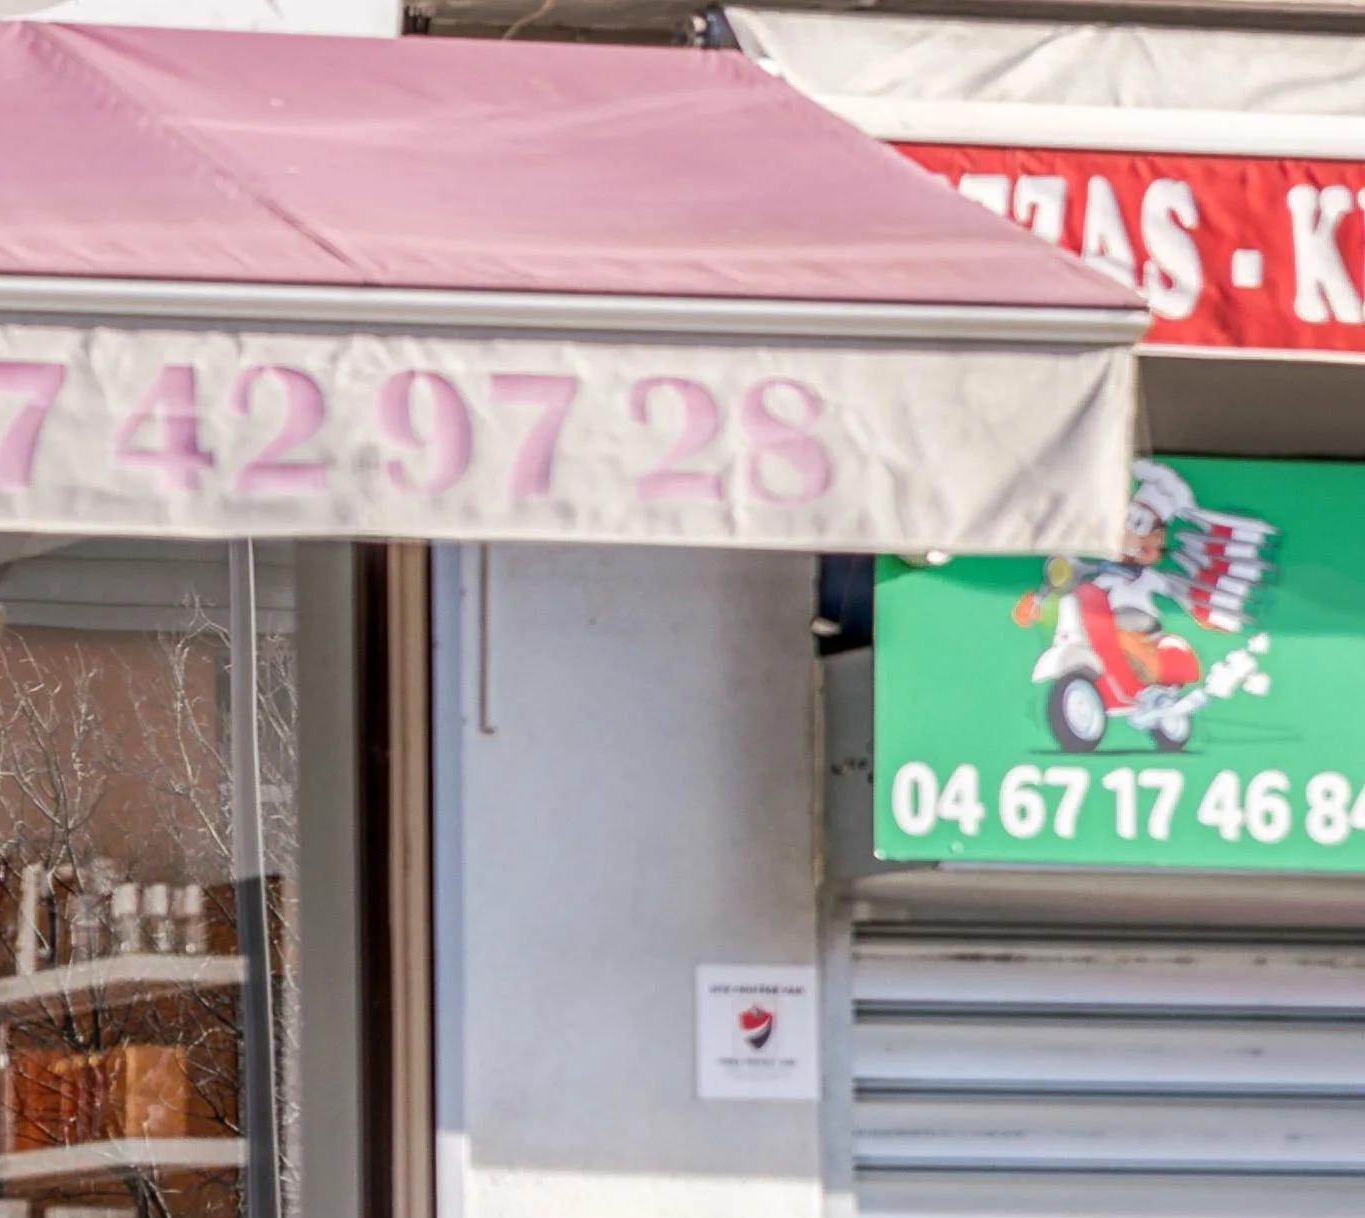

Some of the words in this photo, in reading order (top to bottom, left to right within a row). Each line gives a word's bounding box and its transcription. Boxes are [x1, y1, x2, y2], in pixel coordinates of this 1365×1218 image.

[1287, 184, 1365, 324] K
[114, 363, 327, 495] 42
[377, 369, 579, 499] 97
[629, 376, 835, 506] 28
[892, 761, 985, 837] 04
[998, 765, 1090, 839] 67
[1102, 767, 1185, 840] 17
[1197, 769, 1293, 844] 46
